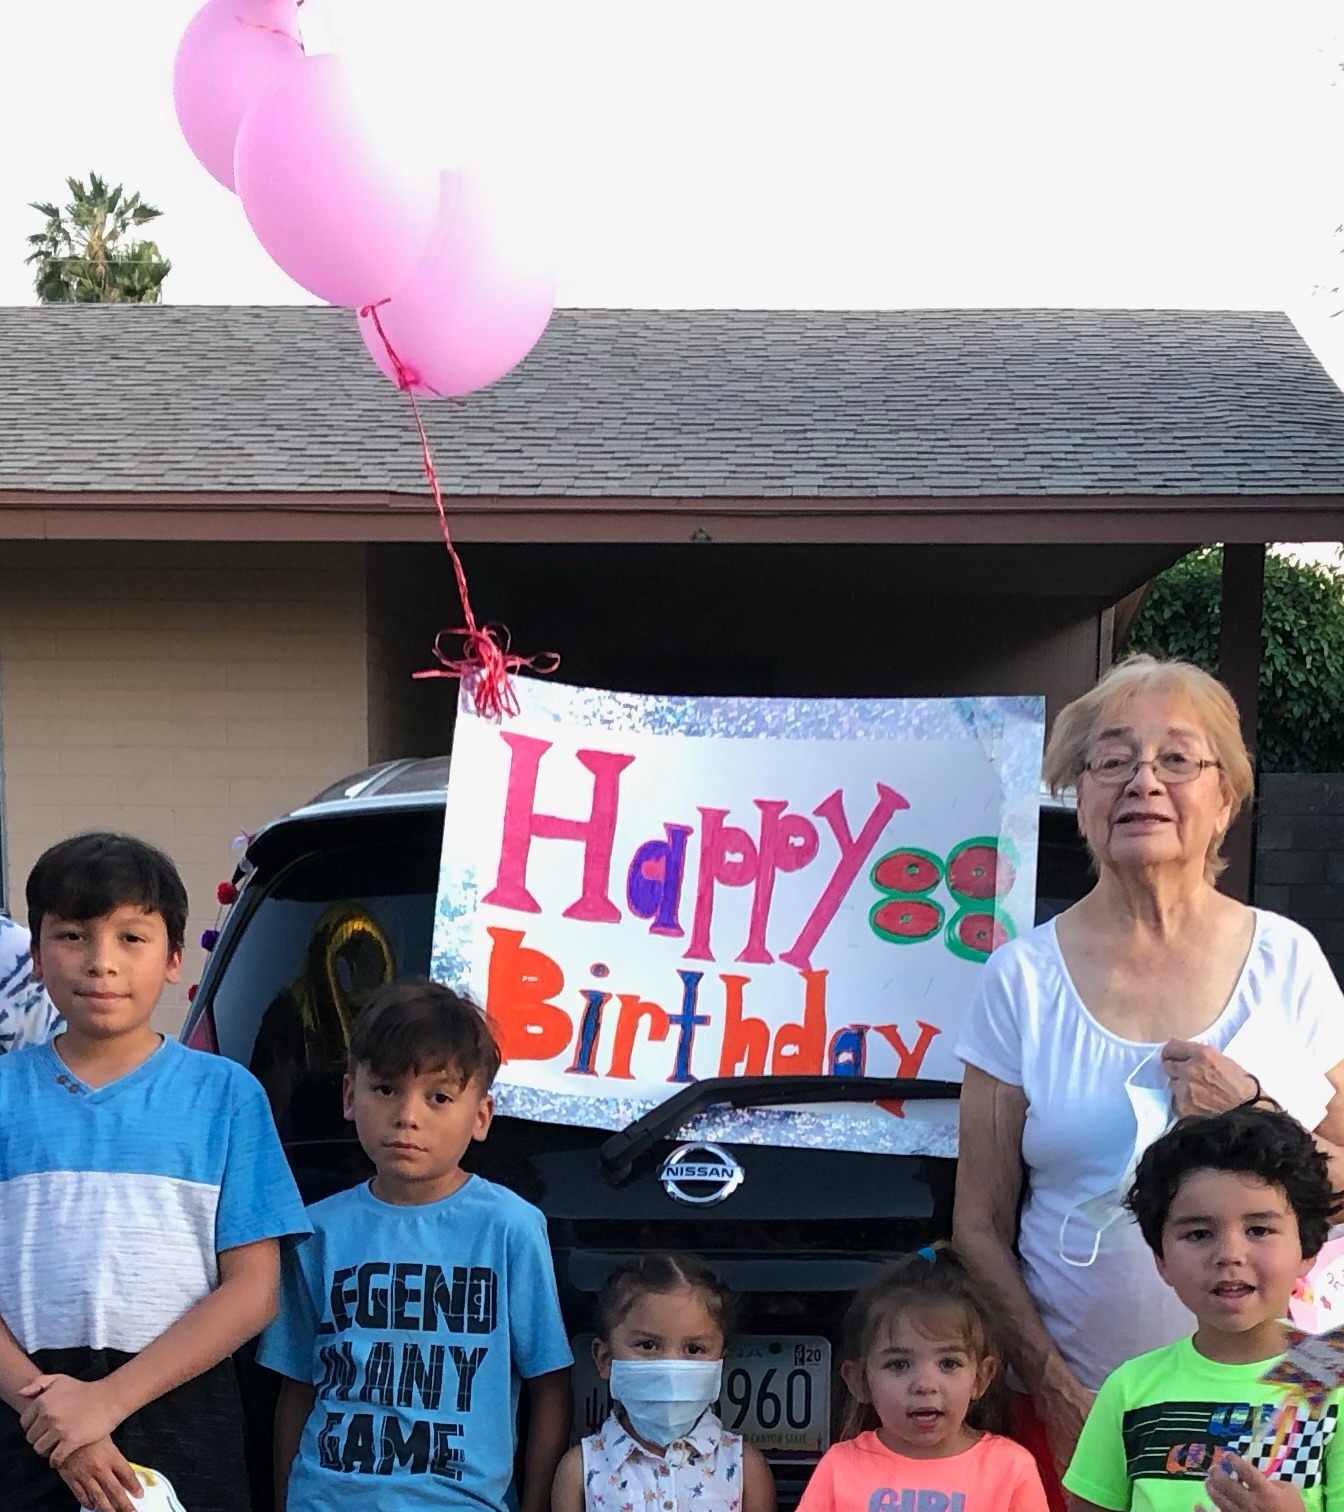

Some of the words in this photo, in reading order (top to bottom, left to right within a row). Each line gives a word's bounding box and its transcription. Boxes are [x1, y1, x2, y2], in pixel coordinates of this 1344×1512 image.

[481, 730, 911, 969] Happy
[868, 835, 1020, 963] 88
[485, 926, 943, 1119] Birthday
[666, 1166, 735, 1179] NISSAN
[806, 1348, 822, 1362] 20
[317, 1411, 465, 1481] GAME
